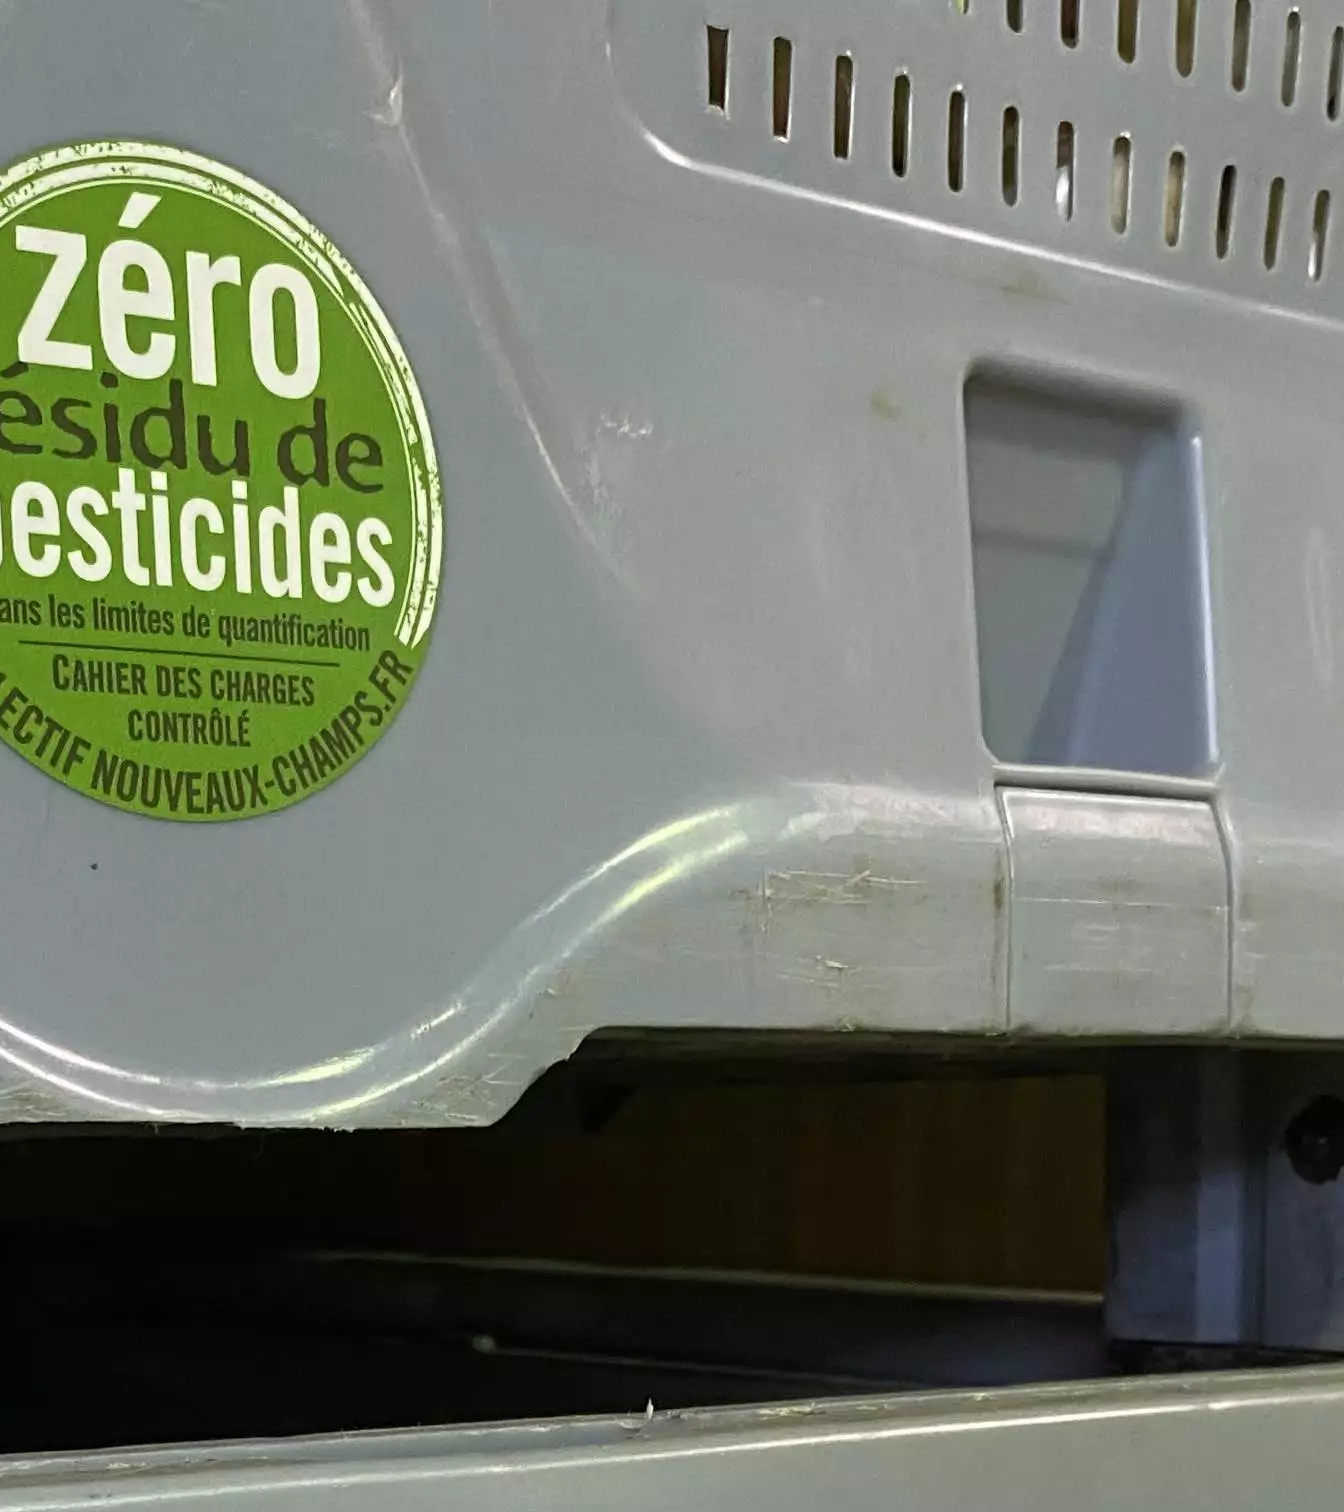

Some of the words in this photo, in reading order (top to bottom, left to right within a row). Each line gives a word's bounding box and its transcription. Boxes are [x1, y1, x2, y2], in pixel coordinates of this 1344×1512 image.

[15, 191, 321, 399] zéro
[276, 397, 384, 493] de
[49, 595, 86, 629] les
[93, 598, 174, 636] limites
[182, 605, 210, 639] de
[218, 611, 370, 652] quantification
[52, 654, 147, 696] CAHIER
[157, 663, 201, 699] DES
[210, 668, 315, 707] CHARGES
[90, 649, 414, 815] NOUVEAUX-CHAMPS.FR
[128, 708, 251, 747] CONTRÔLÉ
